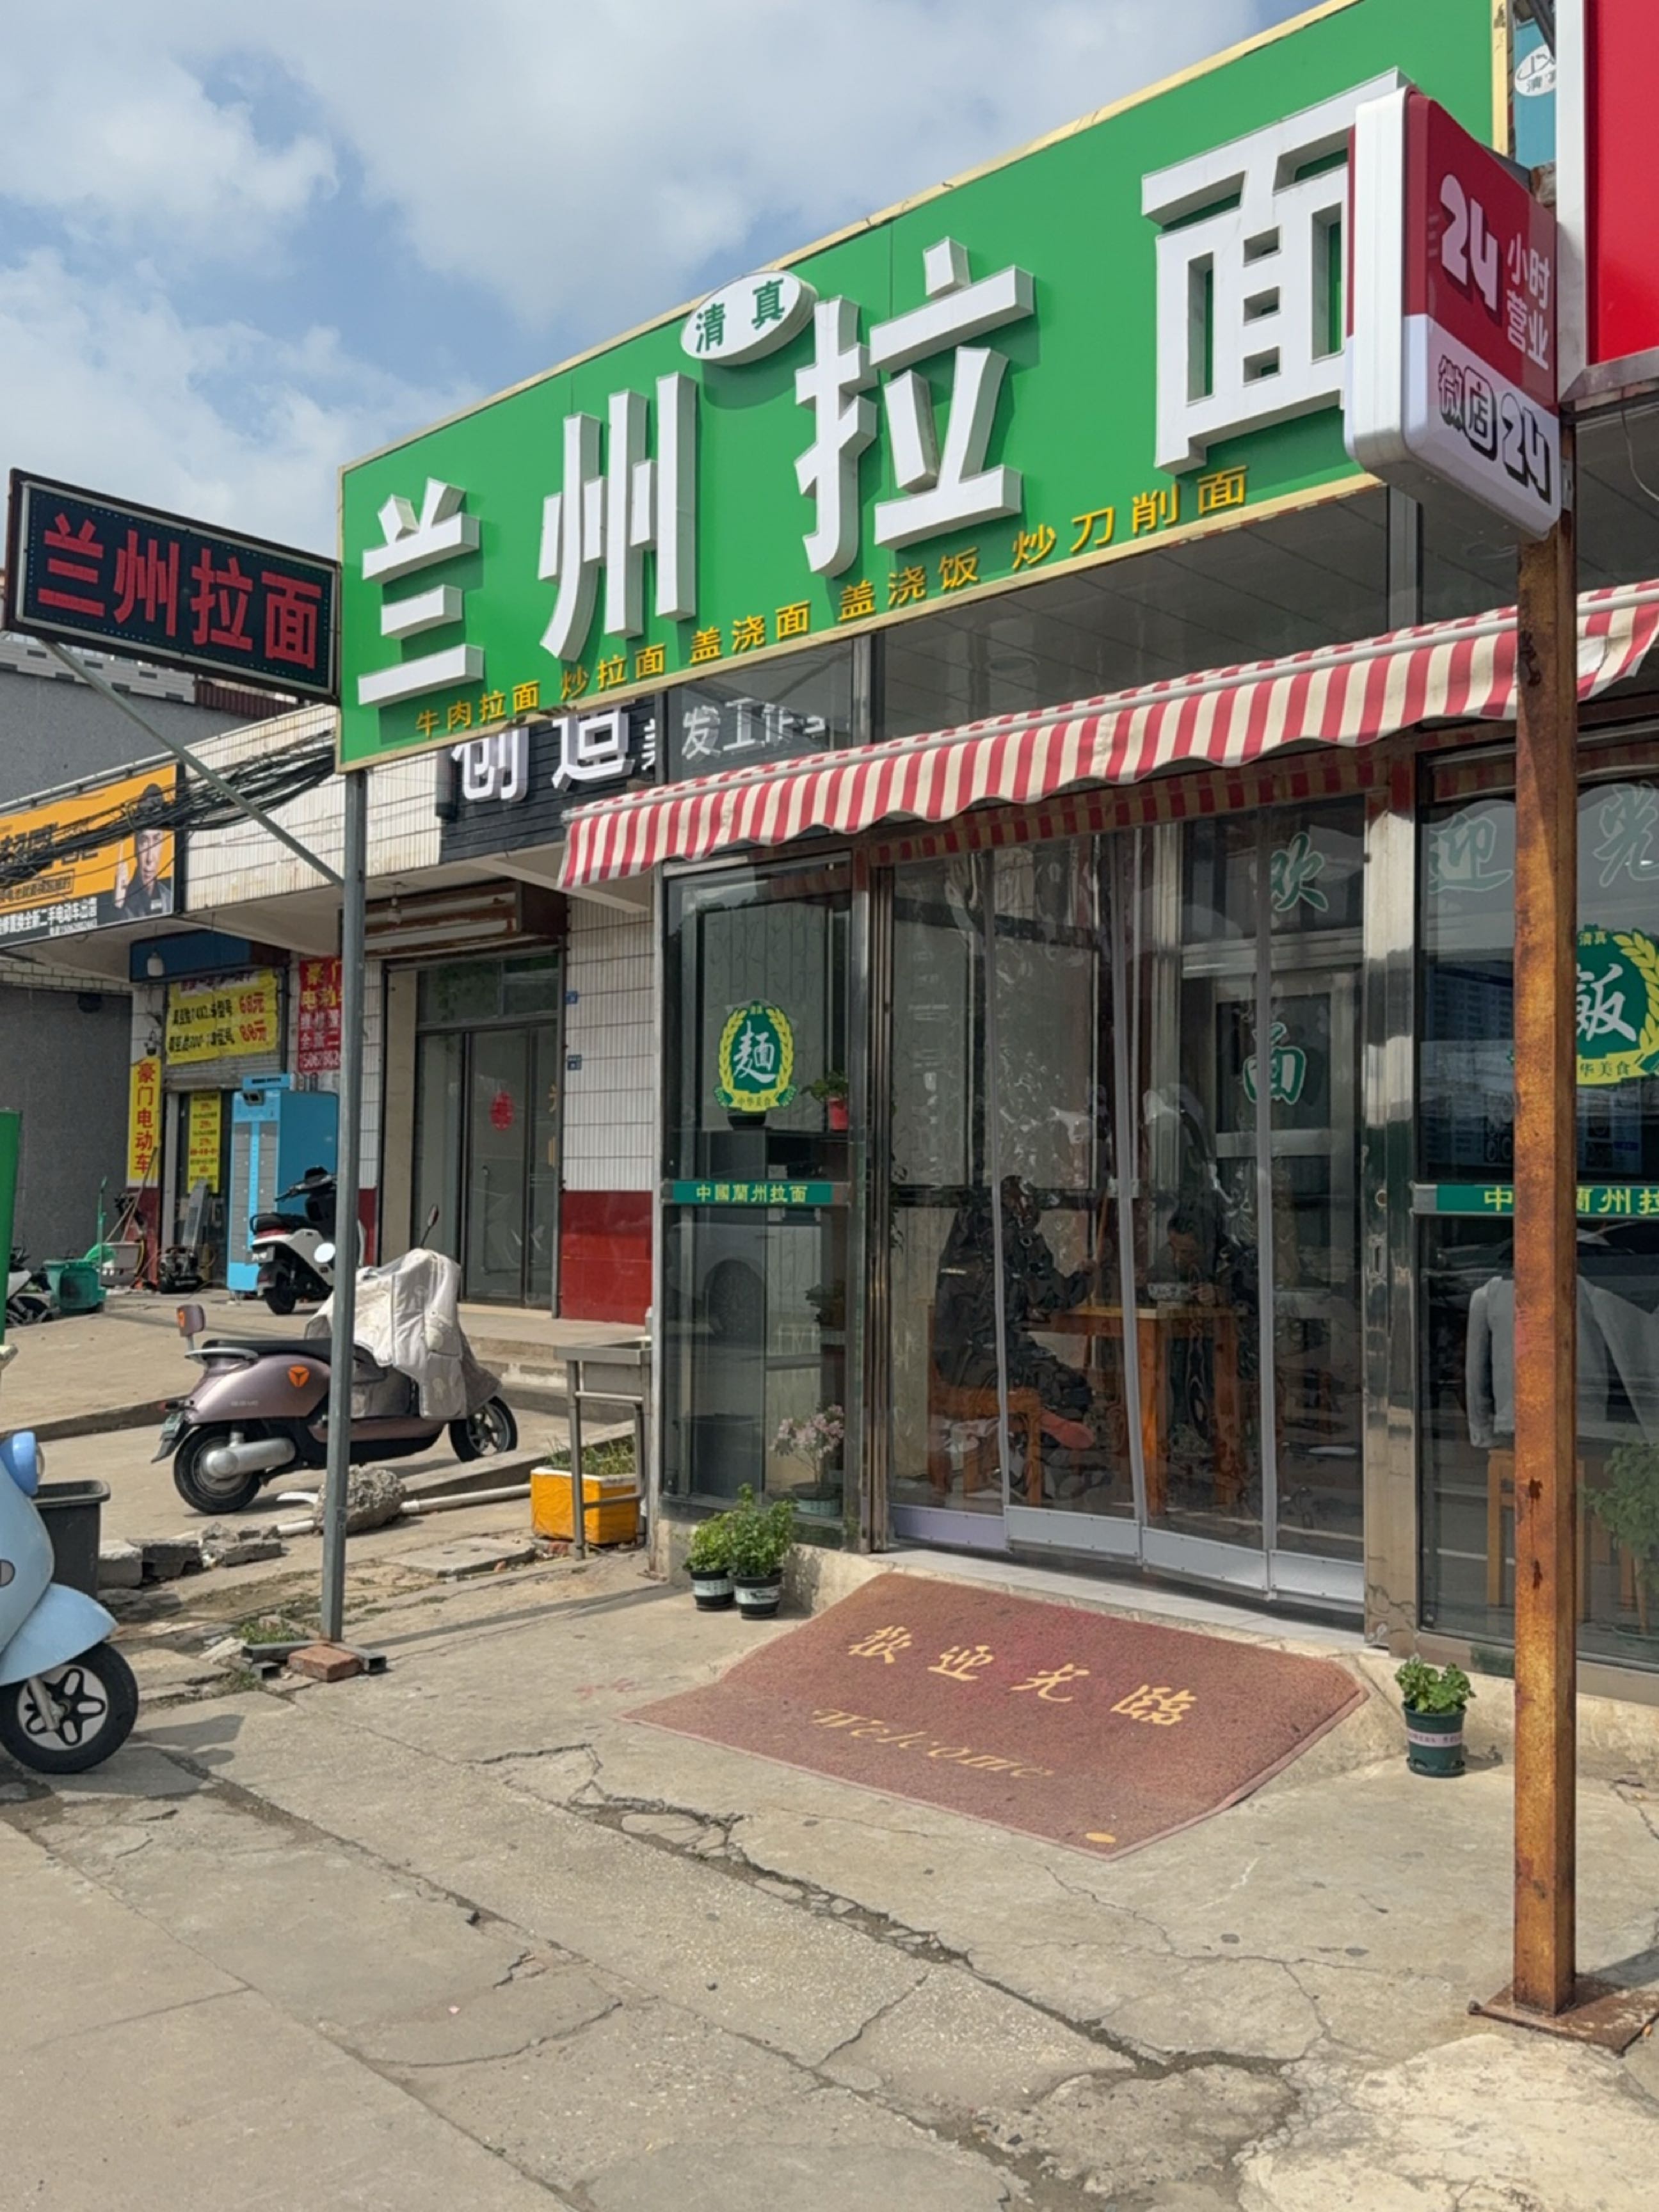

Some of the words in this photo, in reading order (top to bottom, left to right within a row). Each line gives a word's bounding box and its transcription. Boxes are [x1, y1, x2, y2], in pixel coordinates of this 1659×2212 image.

[1439, 173, 1499, 314] 24
[1507, 232, 1551, 310] 小时
[695, 278, 785, 353] 清真
[1506, 288, 1550, 371] 营业
[357, 66, 1406, 710] 兰州拉面
[37, 513, 321, 670] 兰州拉面
[415, 680, 540, 739] 牛肉拉面
[559, 643, 666, 700] 炒拉面
[689, 599, 811, 666] 盖浇面
[837, 547, 979, 622] 盖浇饭
[1011, 464, 1249, 570] 炒刀削面
[733, 1020, 776, 1084] 麵
[1579, 1060, 1630, 1078] 华美食
[134, 1061, 156, 1175] 豪门电动车
[696, 1184, 808, 1204] 中國蘭州拉面
[813, 1708, 1055, 1779] Welcome
